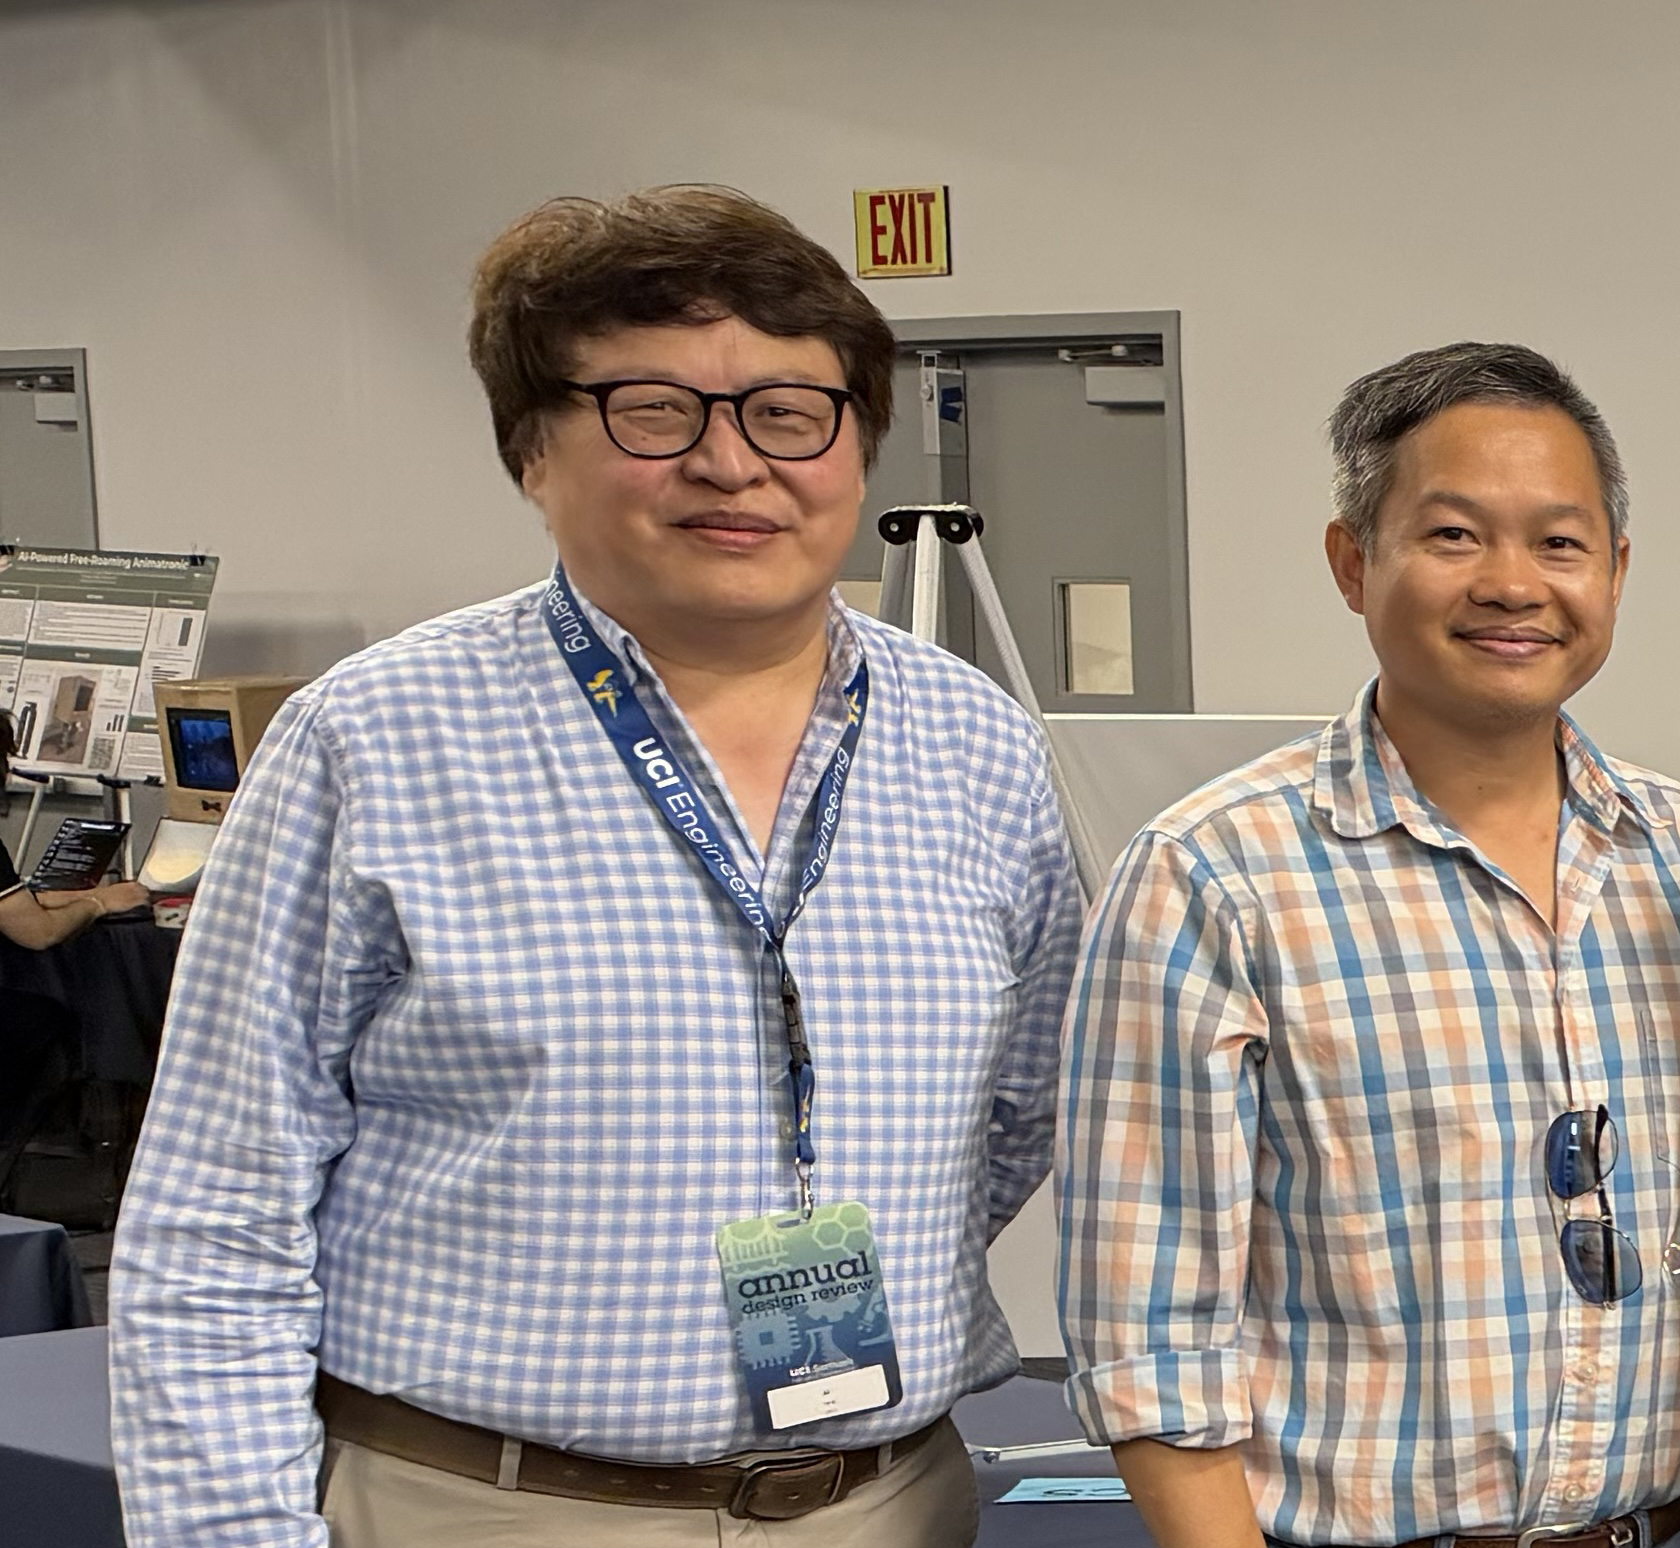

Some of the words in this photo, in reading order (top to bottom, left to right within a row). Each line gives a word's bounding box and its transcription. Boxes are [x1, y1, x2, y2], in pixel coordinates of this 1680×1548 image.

[869, 192, 936, 266] EXIT
[132, 557, 189, 570] Animatronic
[633, 737, 680, 789] UCI
[738, 1250, 873, 1300] annual
[741, 1292, 807, 1315] design
[811, 1279, 875, 1302] review
